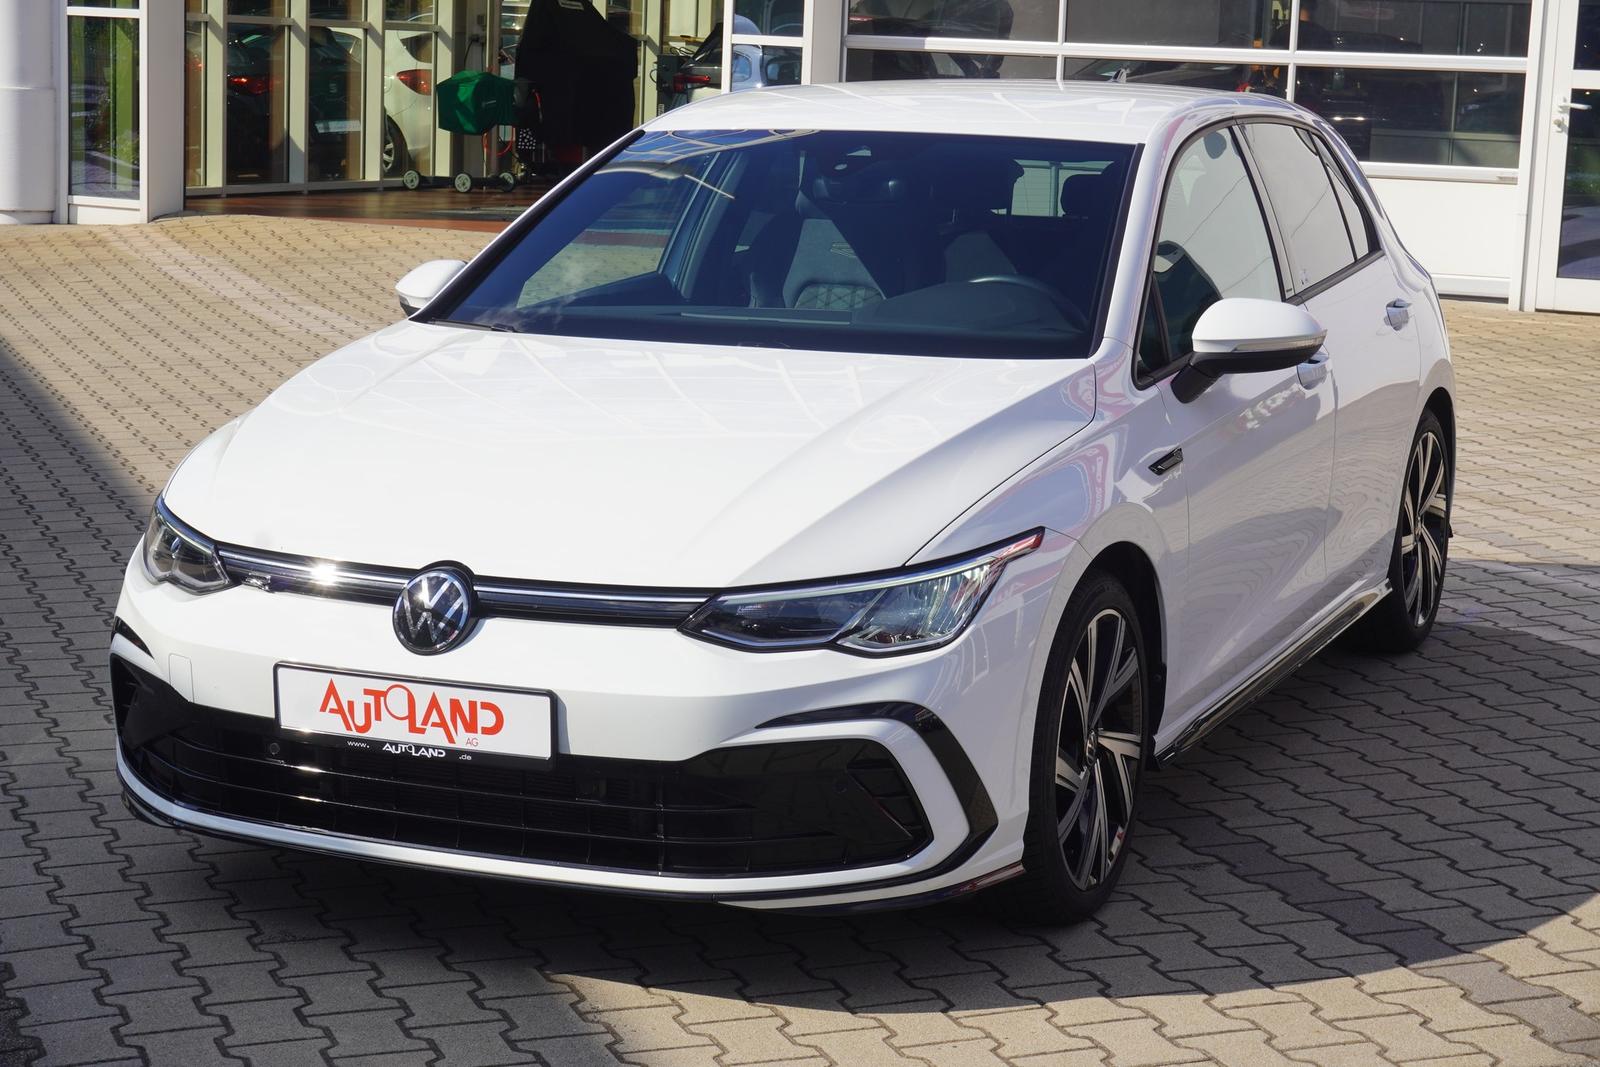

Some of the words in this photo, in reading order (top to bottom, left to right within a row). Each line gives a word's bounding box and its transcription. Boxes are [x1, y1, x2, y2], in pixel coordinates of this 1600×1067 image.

[319, 677, 505, 744] AUTOLAND
[346, 740, 370, 749] www.
[382, 742, 446, 758] AUTOLAND
[465, 737, 479, 747] AG
